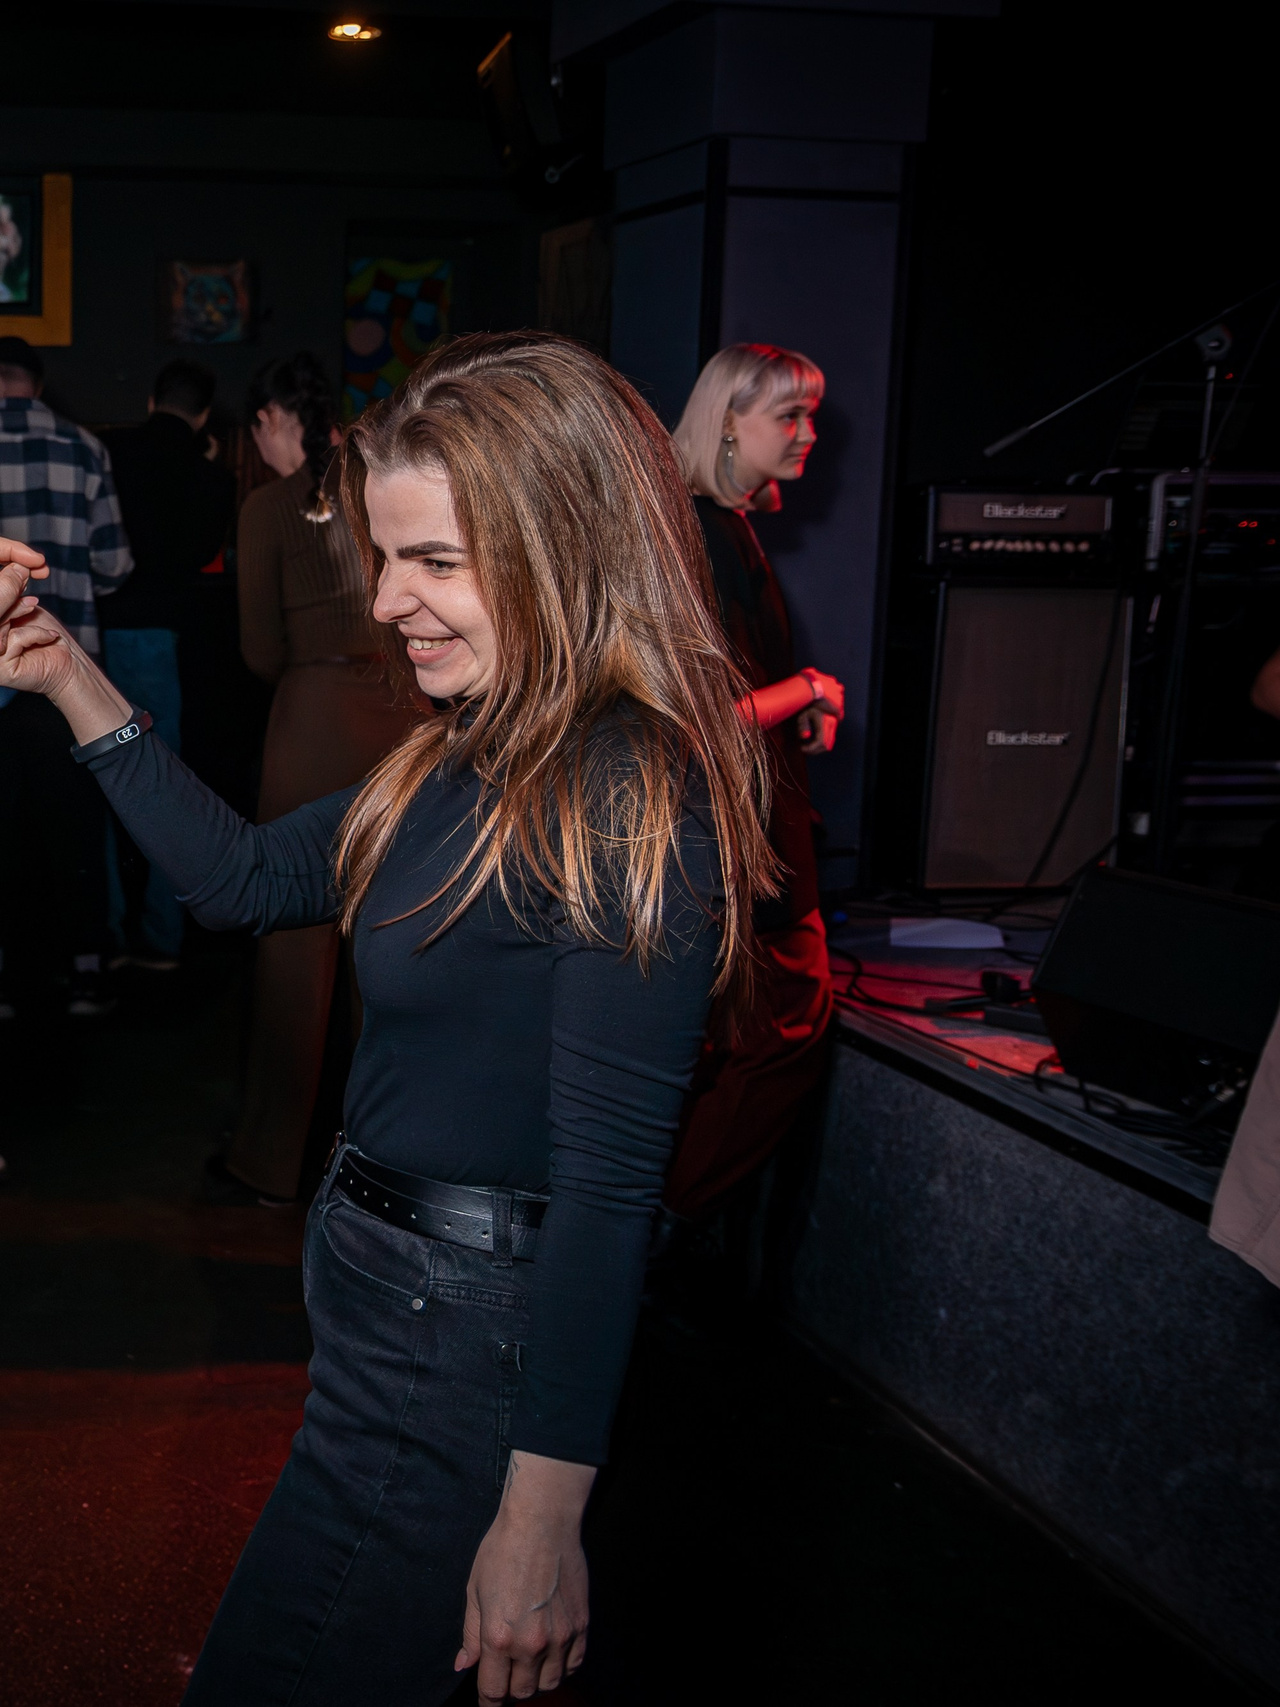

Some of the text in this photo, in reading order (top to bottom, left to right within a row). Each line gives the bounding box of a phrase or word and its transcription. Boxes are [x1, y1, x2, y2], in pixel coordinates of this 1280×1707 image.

[983, 502, 1067, 519] Blackstar
[121, 728, 133, 739] 23
[986, 730, 1071, 746] Blackstar
